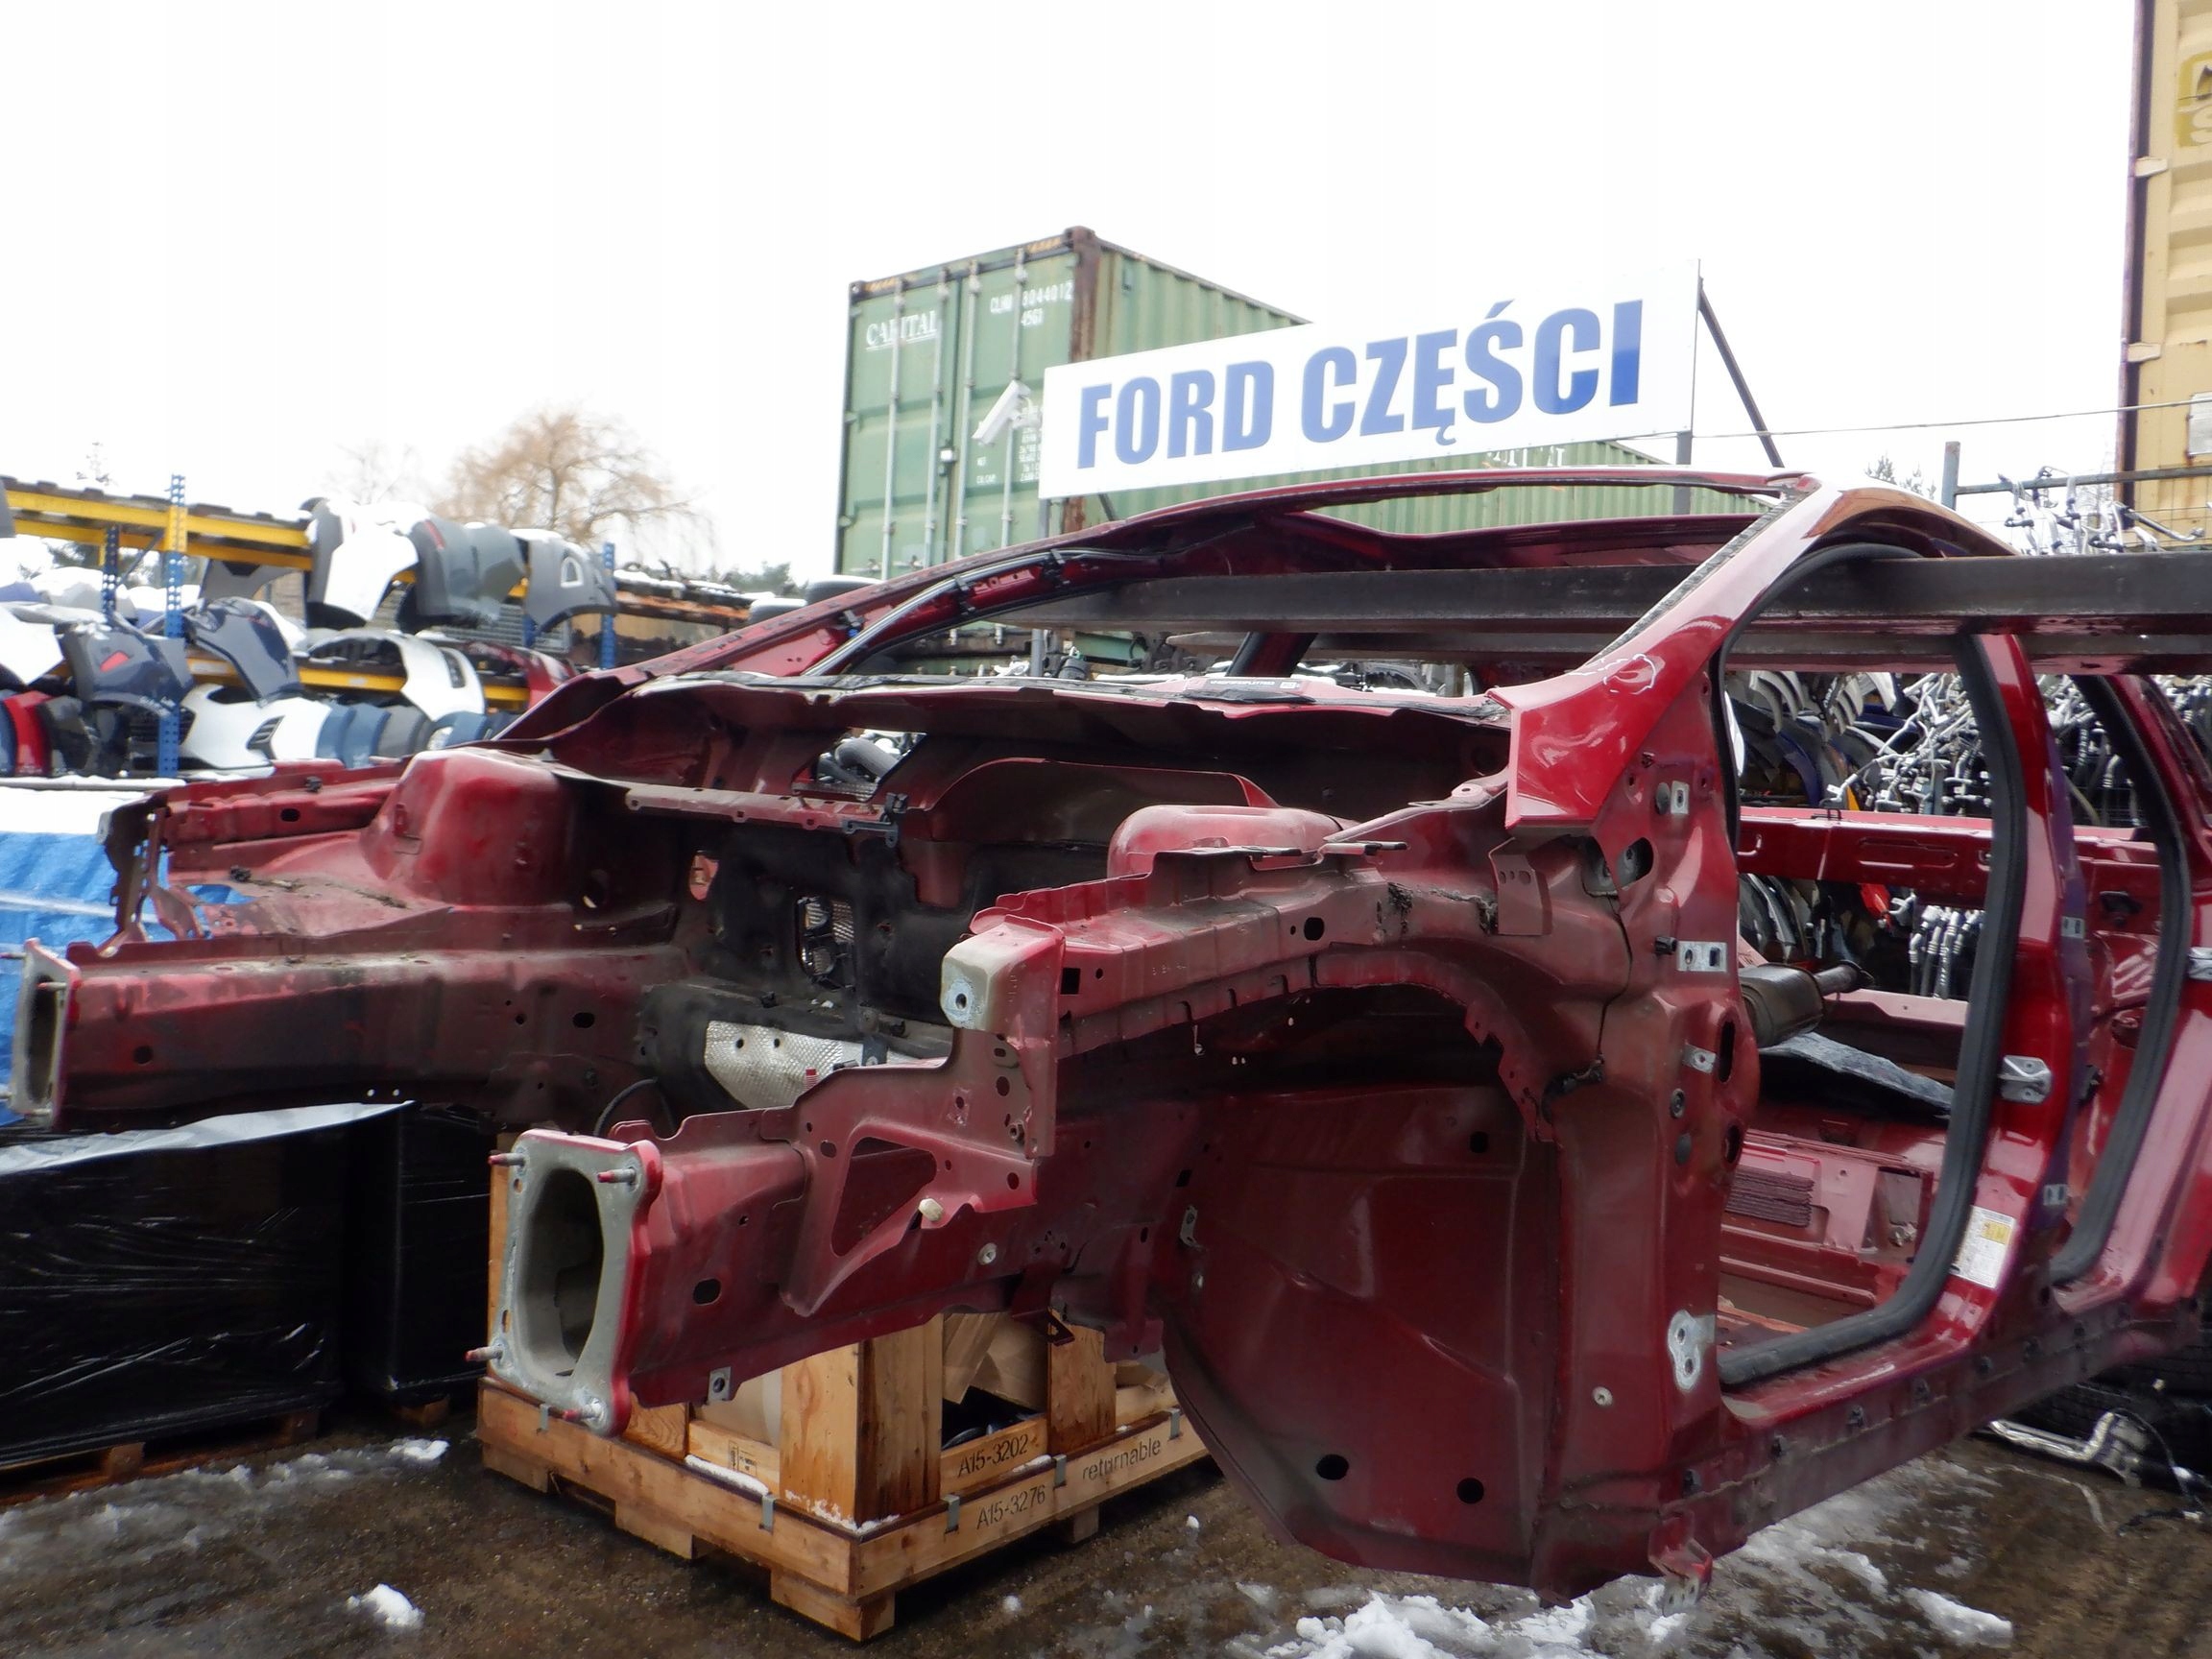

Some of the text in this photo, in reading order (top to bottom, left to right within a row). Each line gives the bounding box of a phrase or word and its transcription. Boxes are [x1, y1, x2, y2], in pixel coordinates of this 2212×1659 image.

[1077, 360, 1275, 469] FORD
[1301, 299, 1644, 446] CZĘŚCI
[957, 1433, 1029, 1478] A15-3202
[1082, 1436, 1162, 1481] returnable
[976, 1484, 1046, 1529] A15-3276
